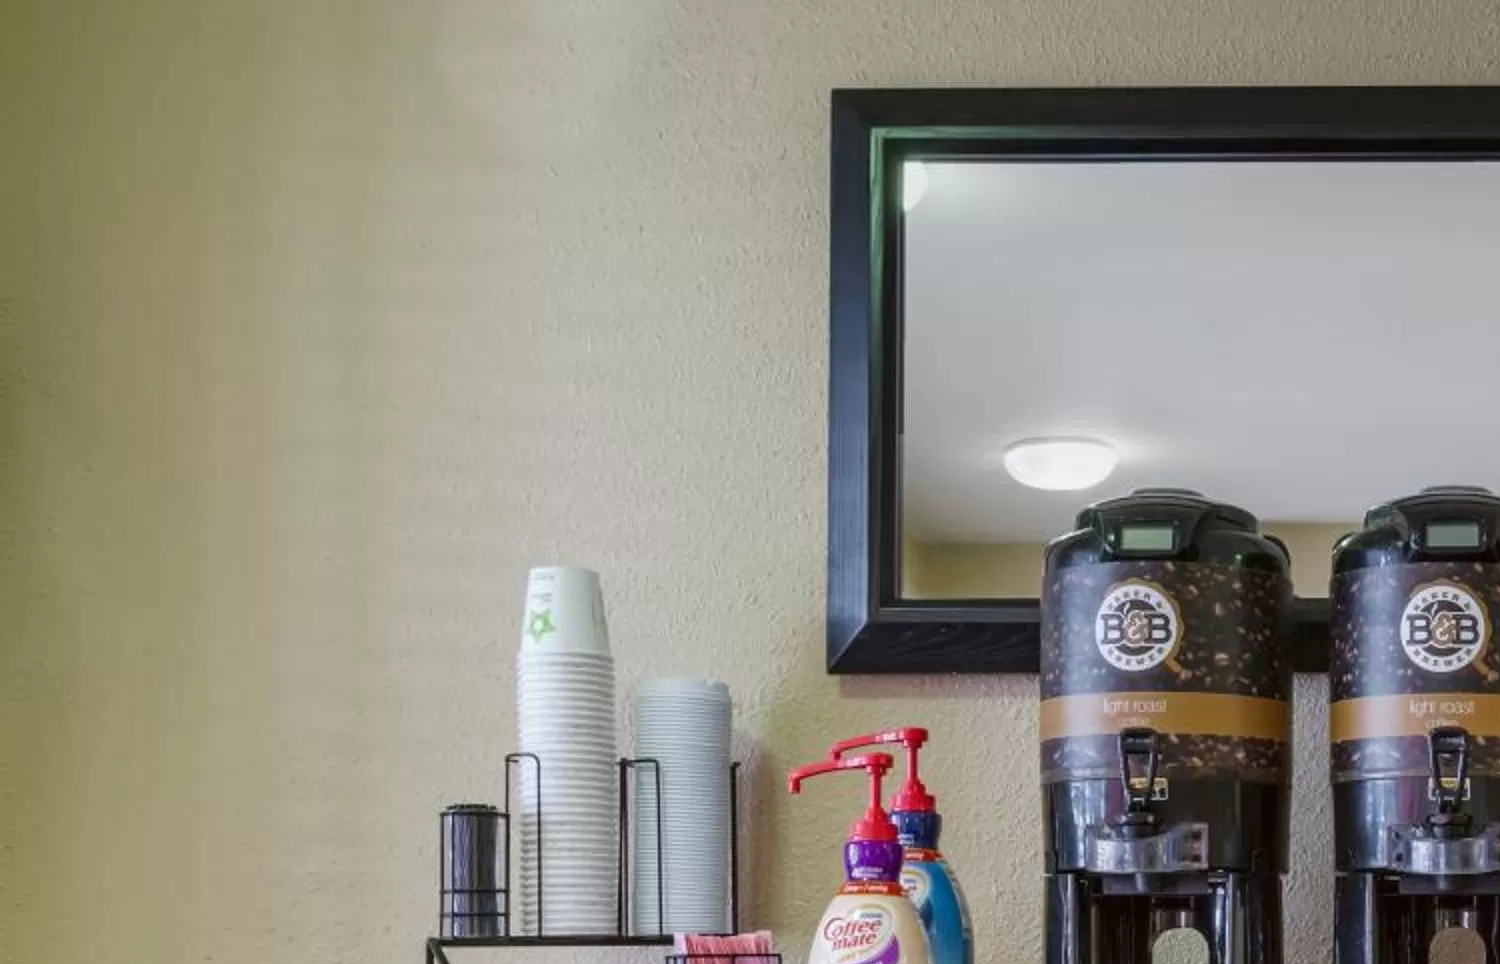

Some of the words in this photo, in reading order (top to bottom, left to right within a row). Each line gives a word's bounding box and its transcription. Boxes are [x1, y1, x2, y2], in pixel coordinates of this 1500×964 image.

[1408, 699, 1437, 717] light
[1439, 701, 1476, 714] roast
[823, 916, 883, 942] Coffee
[832, 932, 877, 950] mate
